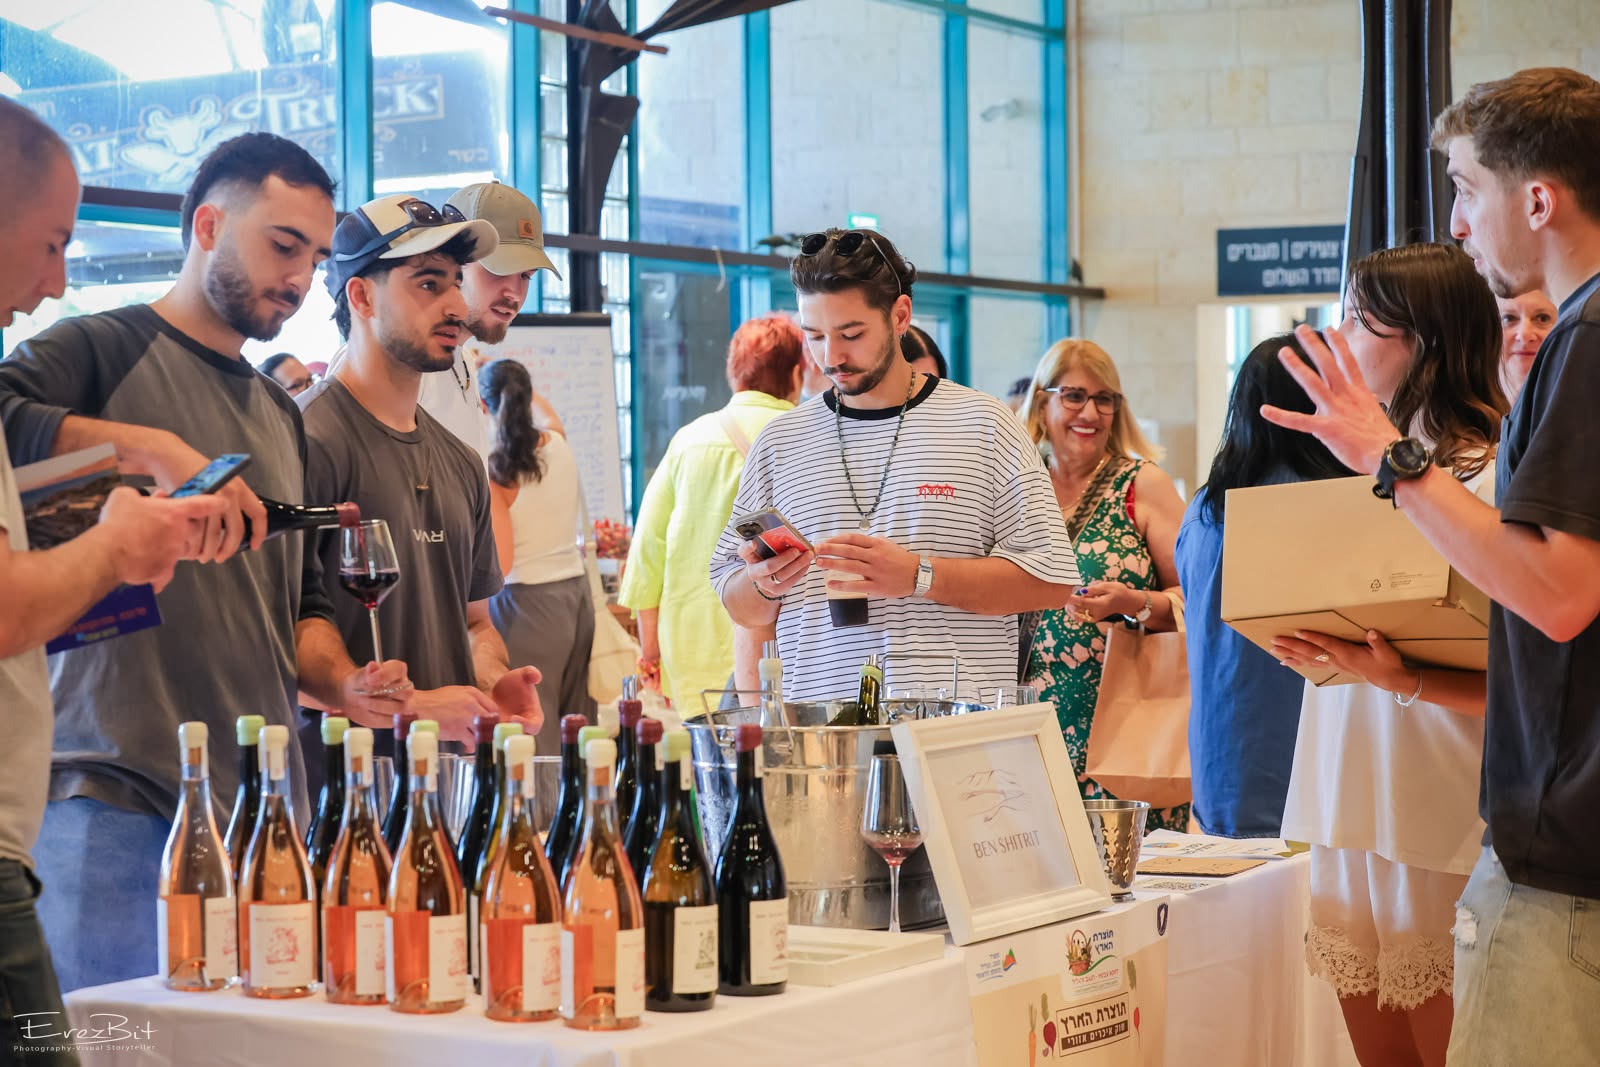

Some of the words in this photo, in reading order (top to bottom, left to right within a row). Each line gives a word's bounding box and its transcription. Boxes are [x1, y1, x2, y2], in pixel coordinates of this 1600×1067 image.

[973, 841, 998, 859] BEN
[999, 829, 1040, 855] SHITRIT
[1095, 941, 1114, 955] הארץ
[1060, 1011, 1093, 1035] הארץ
[1096, 1002, 1127, 1023] תוצרת
[1089, 1026, 1113, 1041] איכרים
